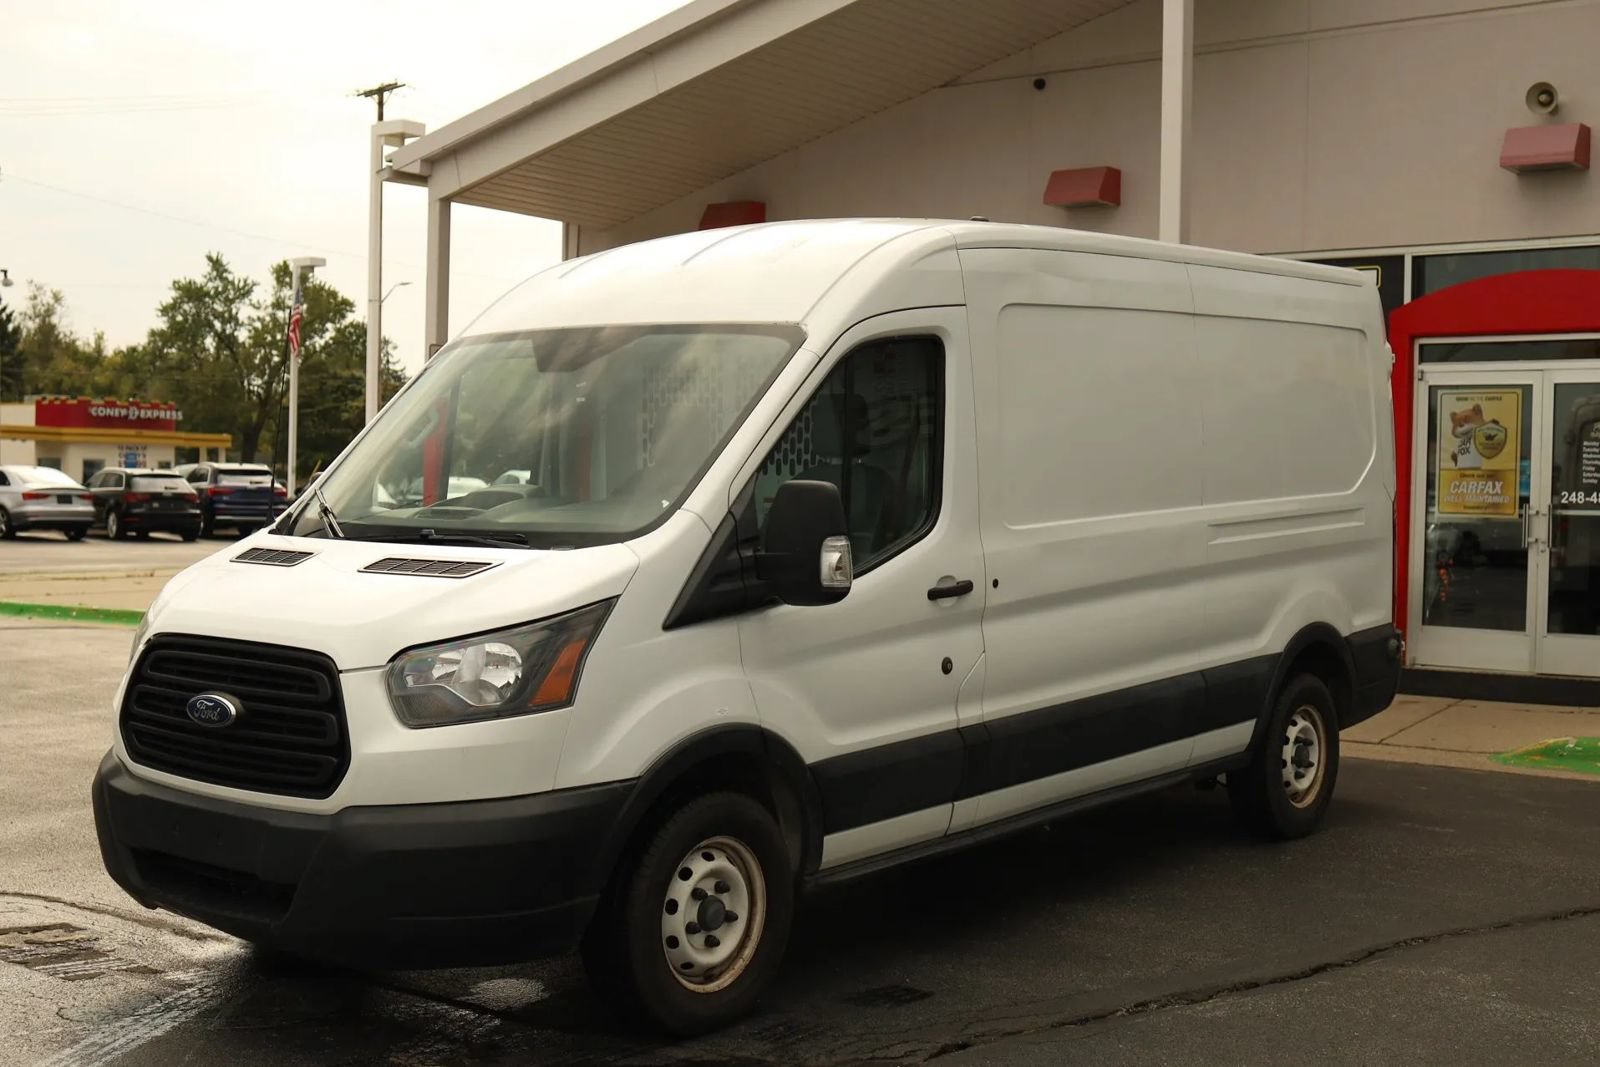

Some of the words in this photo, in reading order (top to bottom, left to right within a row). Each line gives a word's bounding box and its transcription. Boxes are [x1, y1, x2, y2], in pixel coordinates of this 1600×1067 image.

[90, 406, 128, 417] CONEY
[139, 408, 183, 420] EXPRESS
[1450, 480, 1503, 495] CARFAX
[194, 699, 221, 721] Ford
